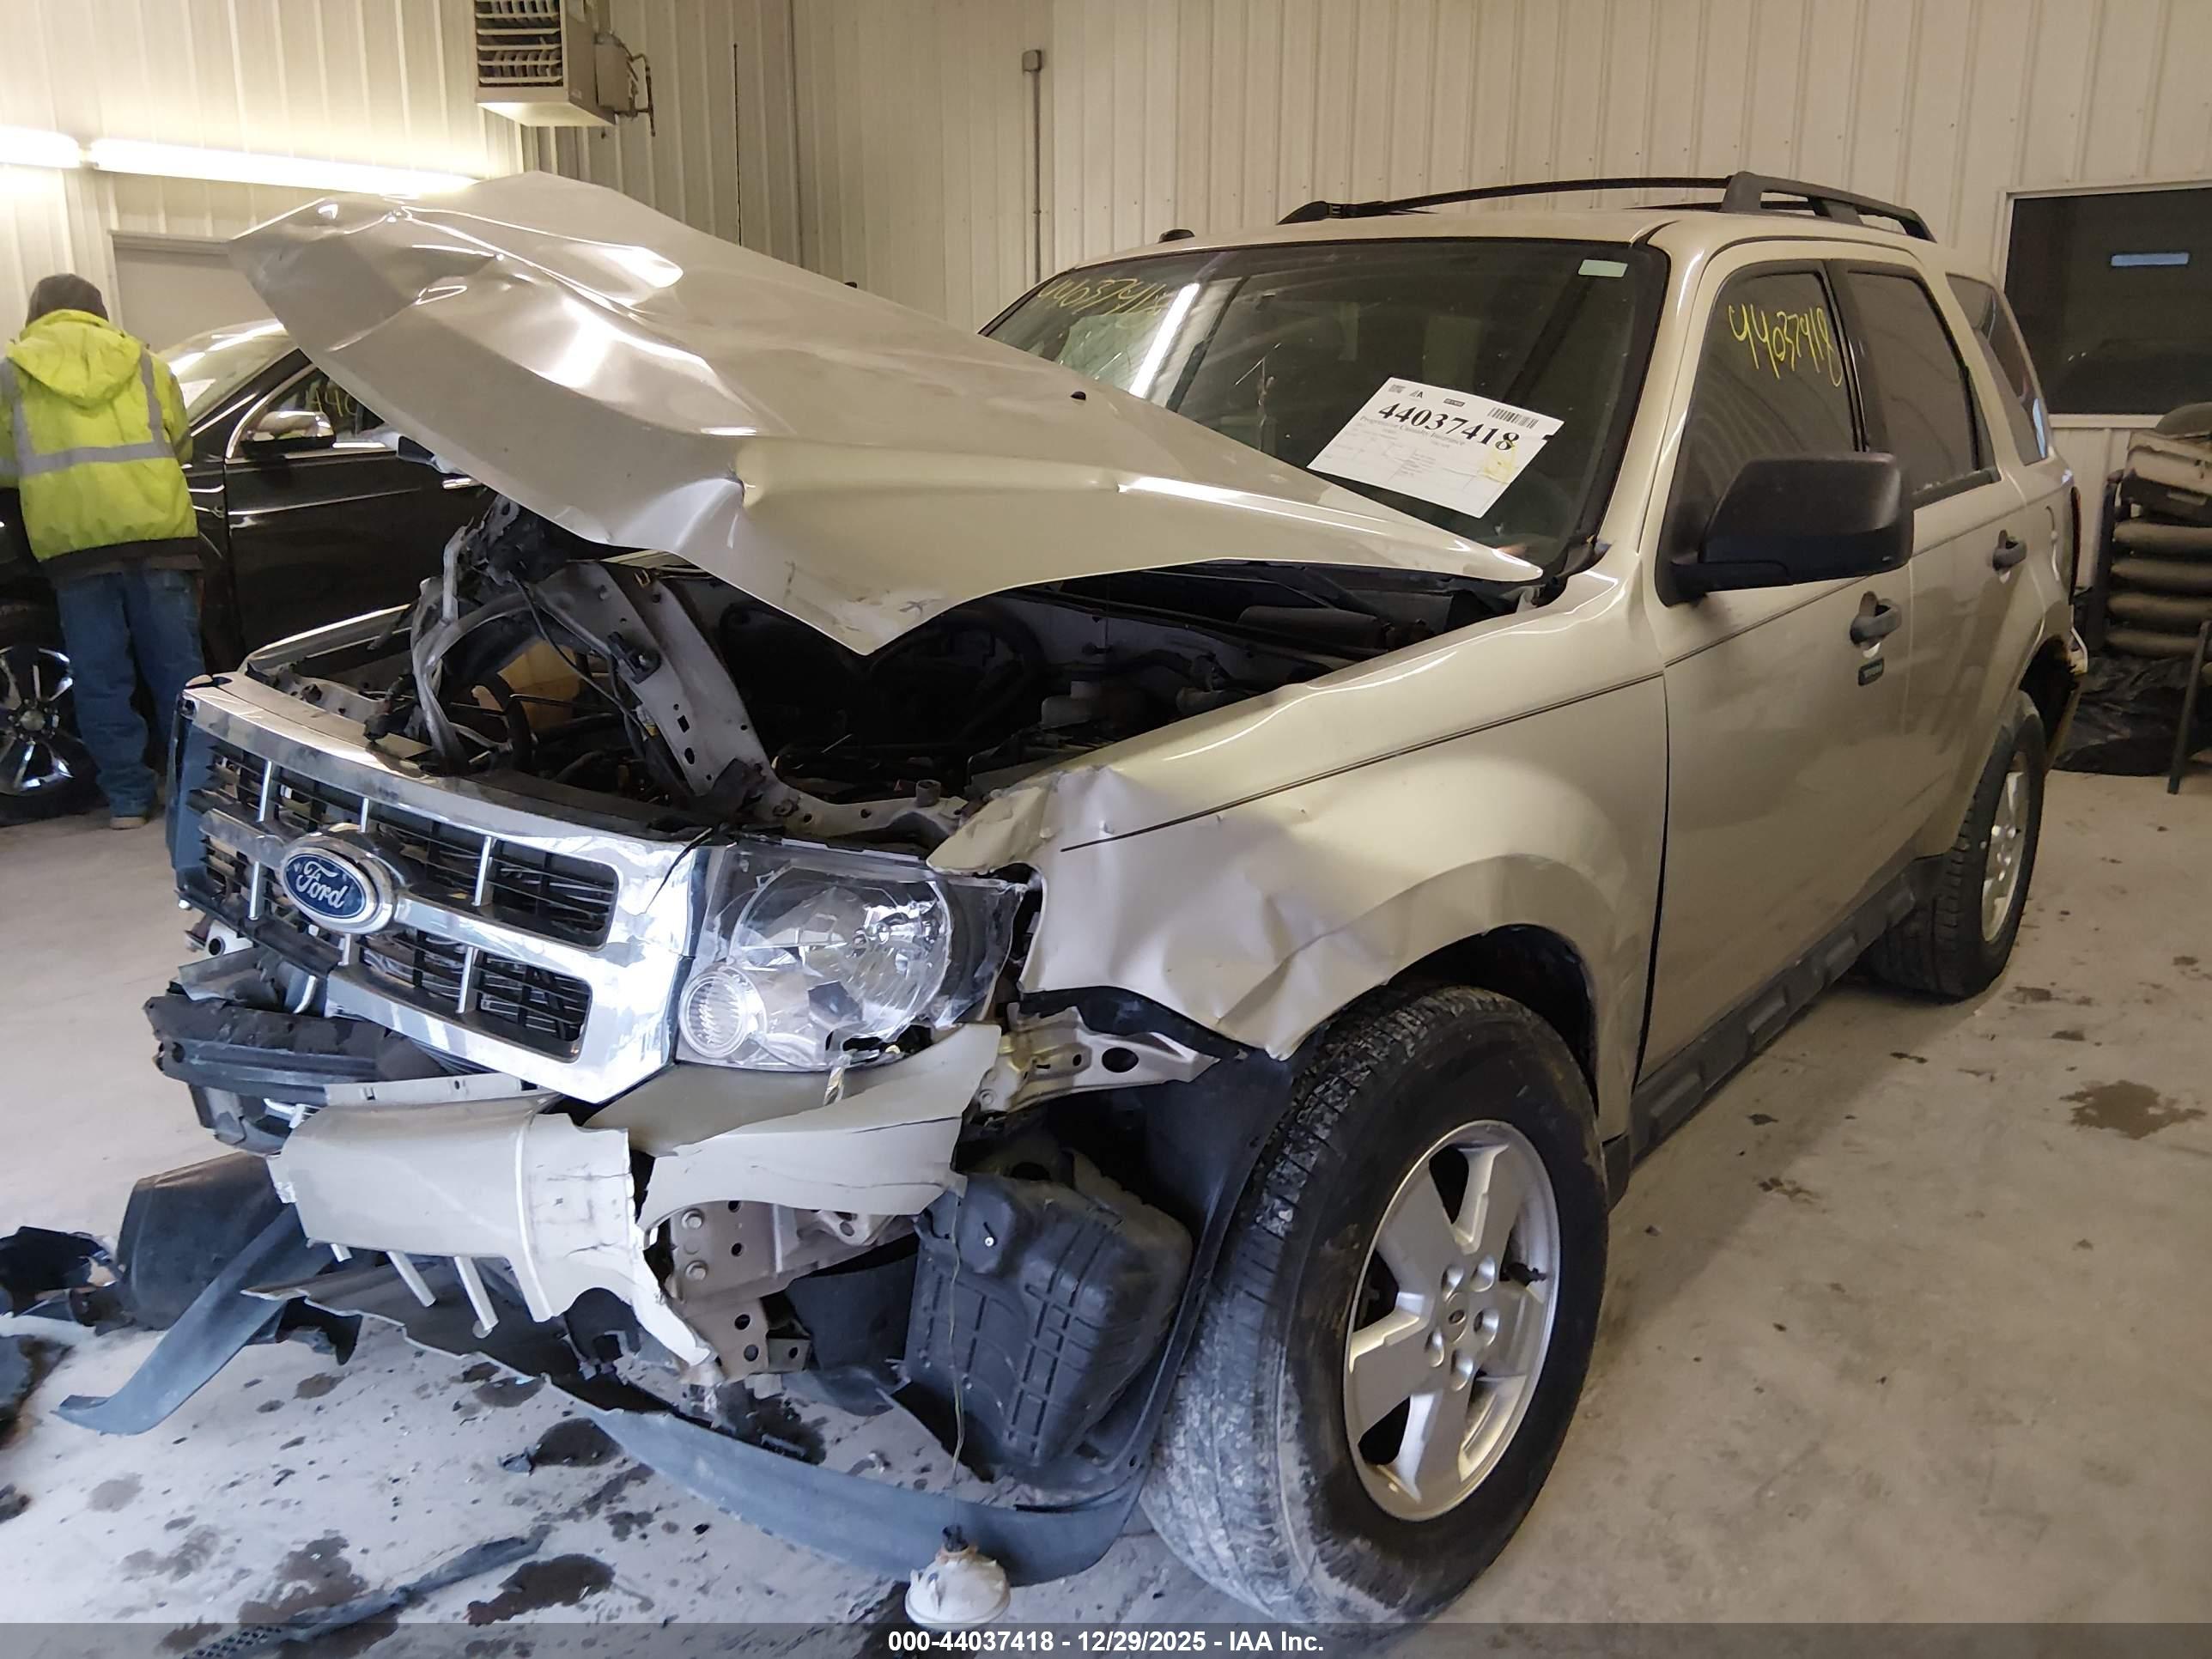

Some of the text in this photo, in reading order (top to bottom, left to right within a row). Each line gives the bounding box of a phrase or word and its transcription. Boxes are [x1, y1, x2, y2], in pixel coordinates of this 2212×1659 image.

[1728, 304, 1844, 387] 44037418
[1378, 403, 1520, 451] 44037418
[295, 860, 349, 908] Ford
